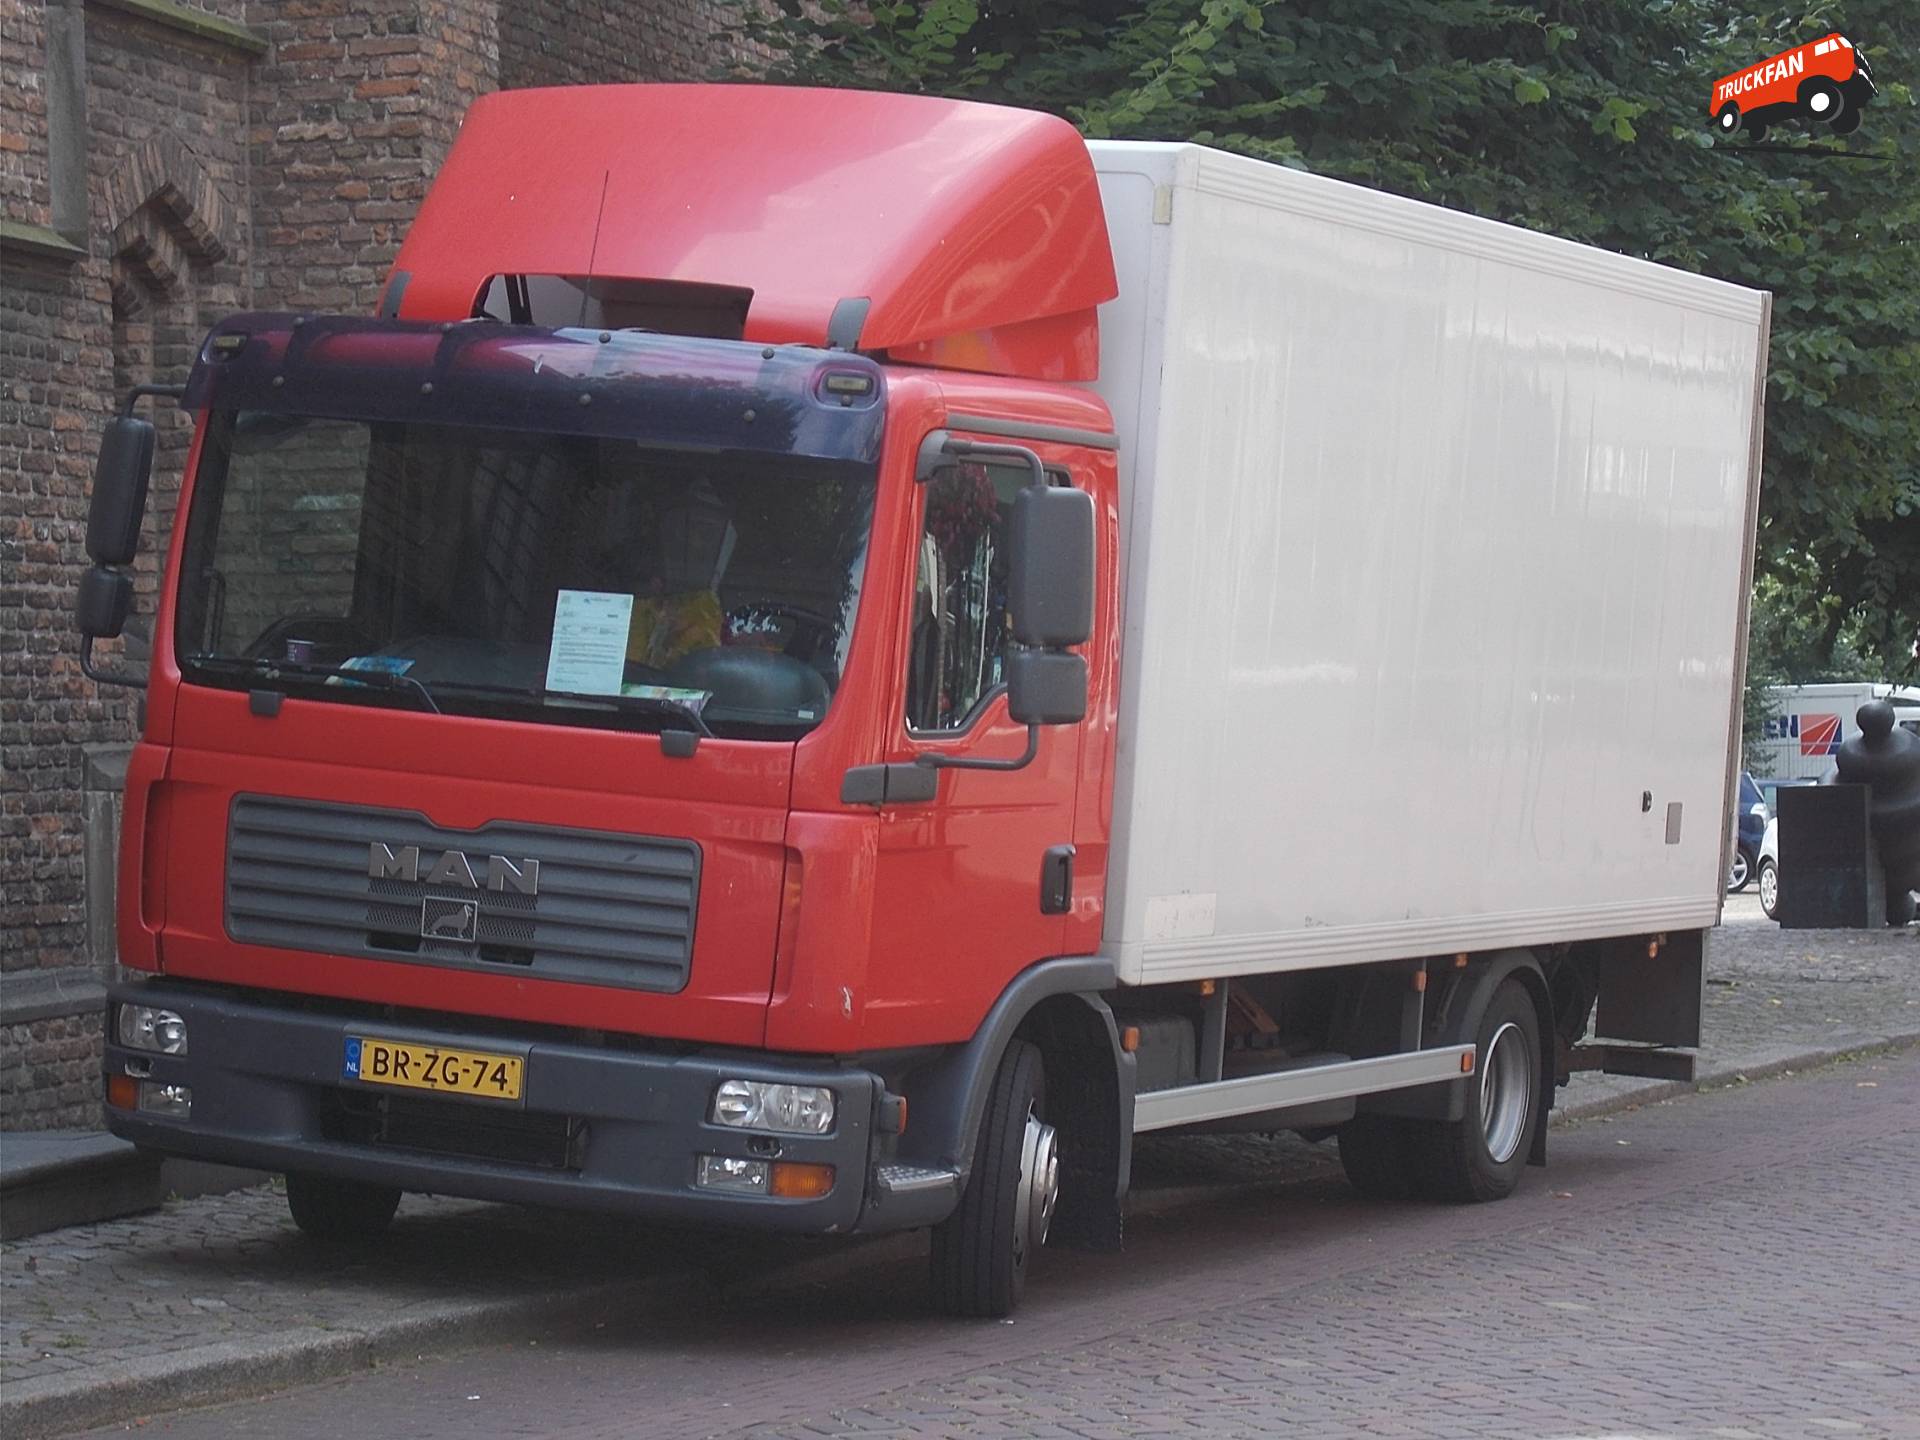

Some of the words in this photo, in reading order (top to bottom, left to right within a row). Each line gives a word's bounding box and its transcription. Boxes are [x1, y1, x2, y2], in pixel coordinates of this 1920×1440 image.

[368, 842, 539, 896] MAN
[346, 1061, 358, 1073] NL
[372, 1047, 508, 1091] BR-ZG-74
